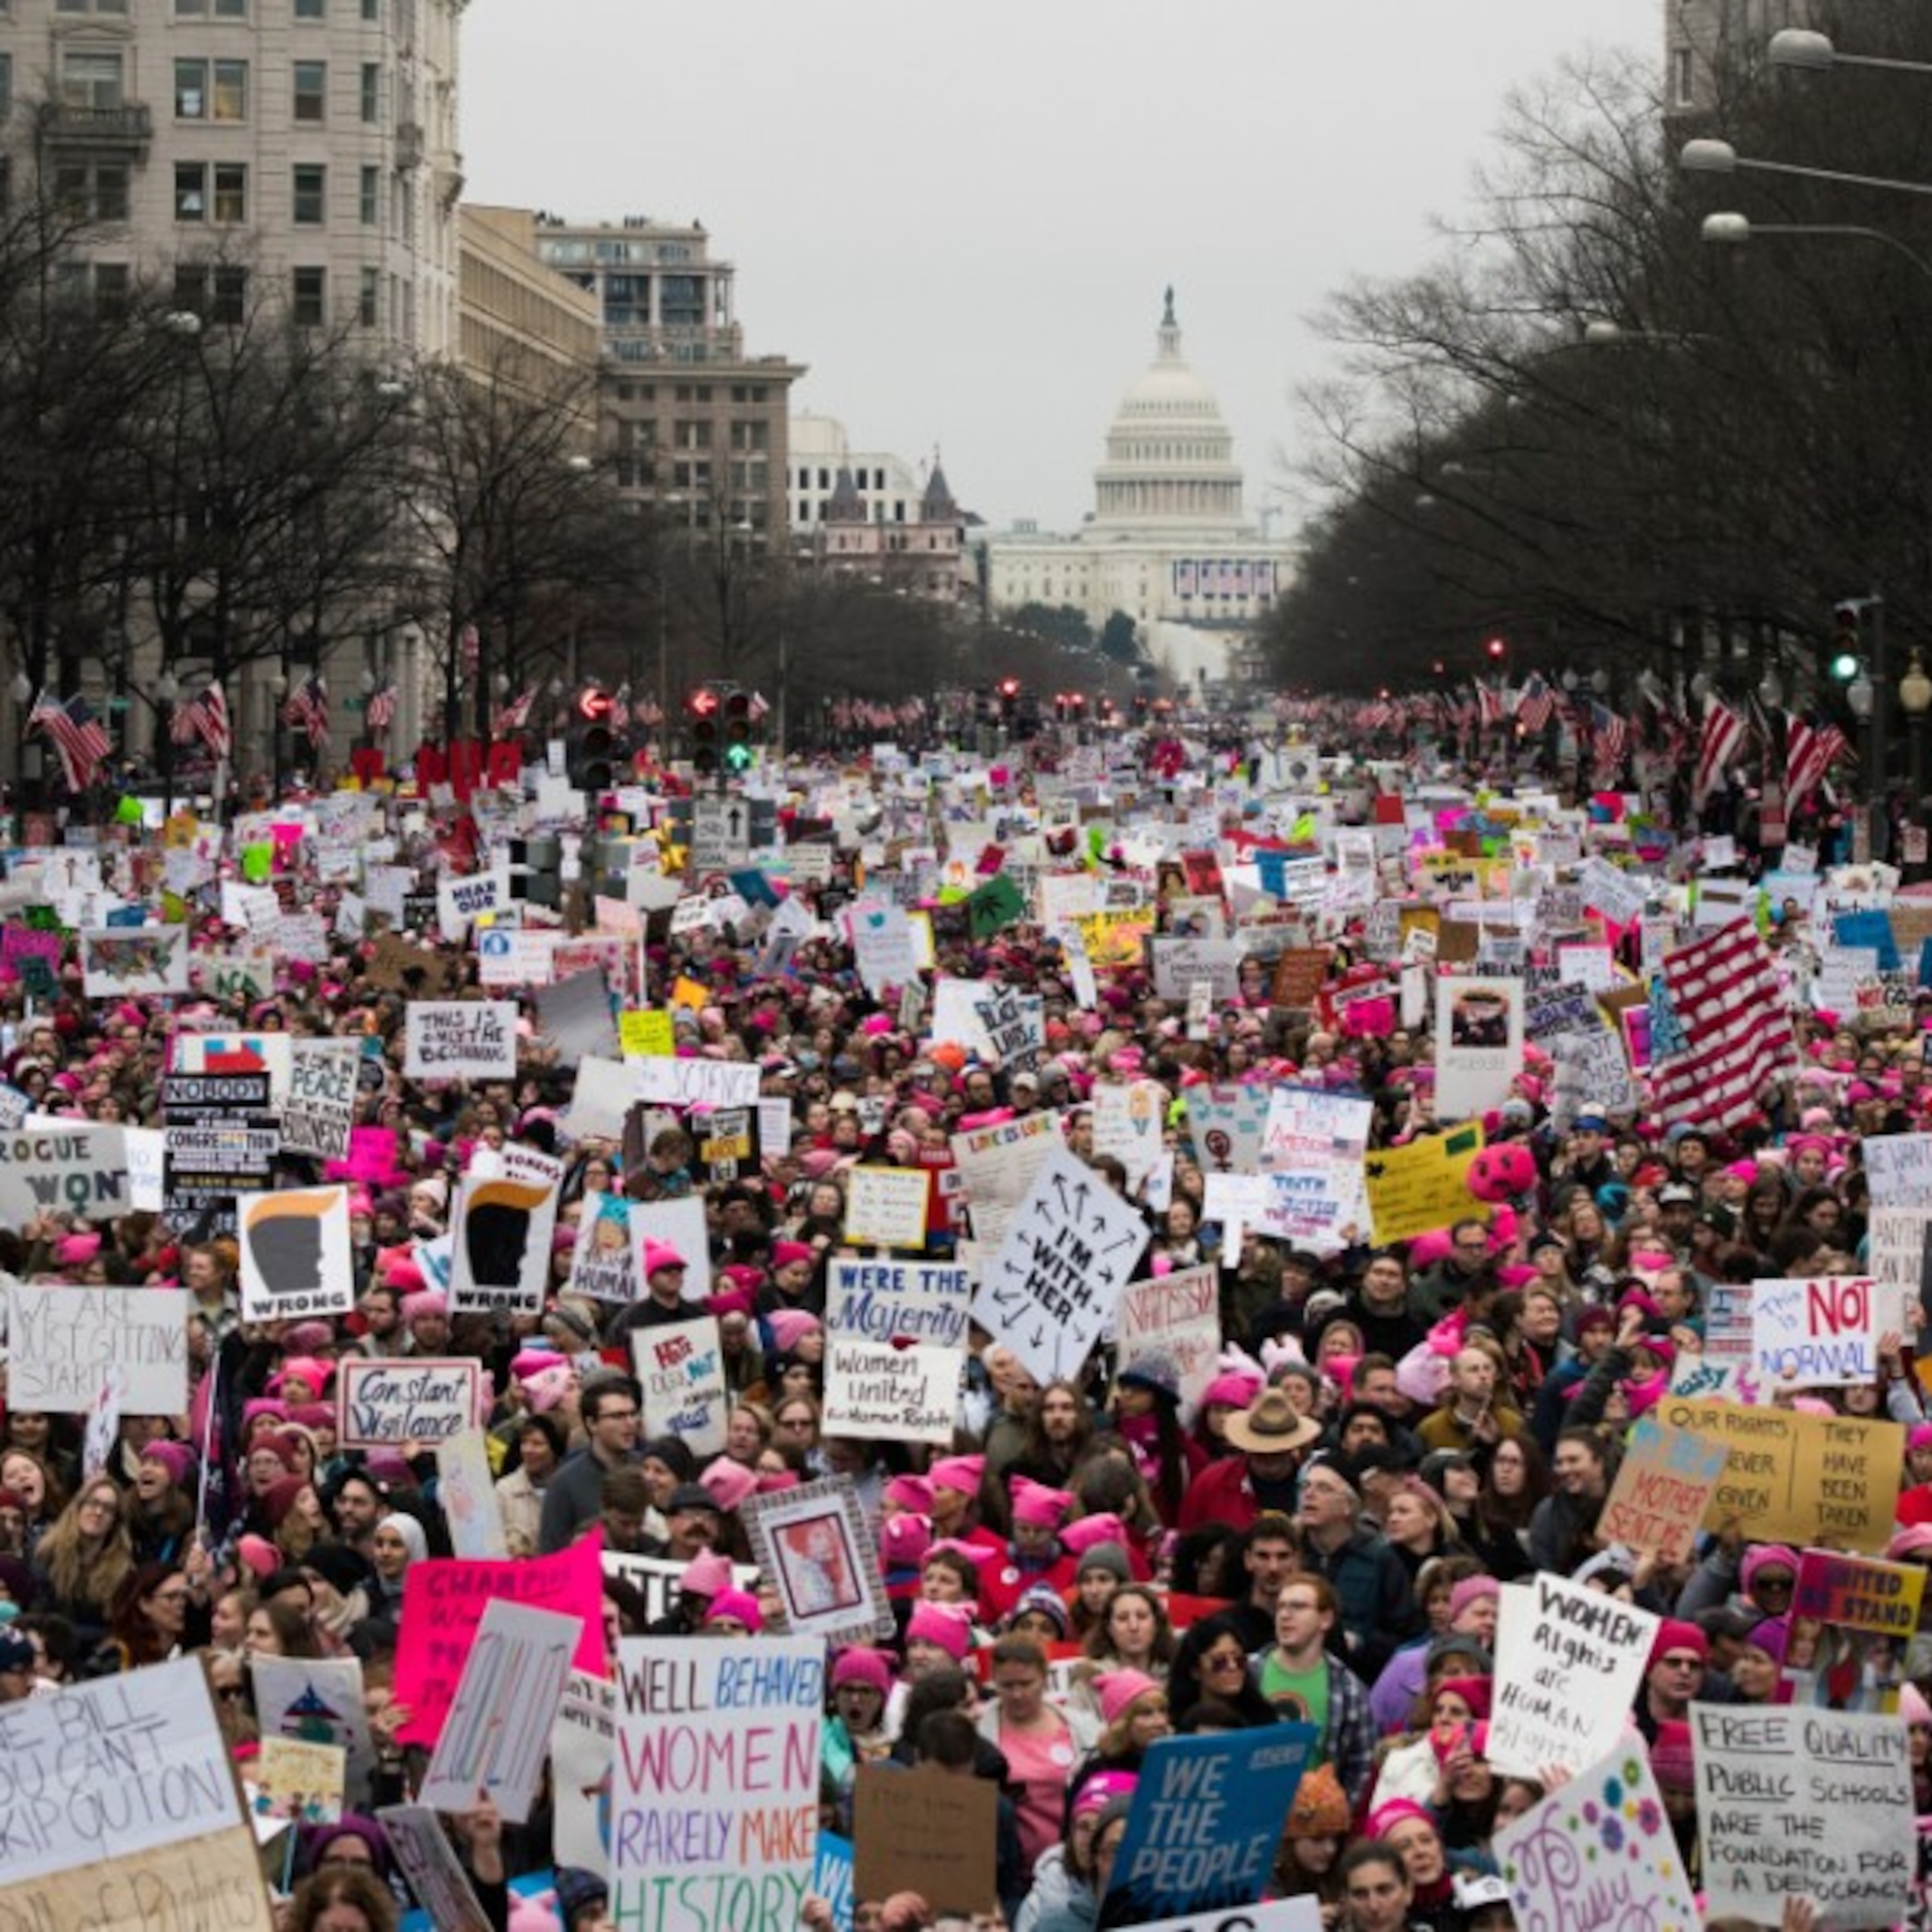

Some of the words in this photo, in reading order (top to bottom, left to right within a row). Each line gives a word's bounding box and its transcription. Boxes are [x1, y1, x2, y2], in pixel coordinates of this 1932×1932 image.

[453, 881, 497, 900] HEAR
[459, 896, 495, 914] OUR
[419, 1011, 464, 1028] THIS
[476, 1009, 497, 1027] IS
[468, 1027, 504, 1042] THE
[168, 1079, 263, 1101] NOBODY
[292, 1068, 350, 1103] PEACE
[968, 1133, 1000, 1153] LOVE
[1003, 1128, 1019, 1143] IS
[1021, 1118, 1053, 1139] LOVE
[1054, 1225, 1094, 1272] I'M
[839, 1265, 905, 1289] WERE
[920, 1269, 968, 1293] THE
[1032, 1237, 1094, 1310] WITH
[14, 1291, 53, 1323] WE
[78, 1290, 137, 1320] ARE
[252, 1293, 347, 1315] WRONG
[456, 1292, 538, 1311] WRONG
[1023, 1270, 1074, 1327] HER
[1806, 1279, 1877, 1337] NOT
[829, 1292, 967, 1342] Majority
[835, 1350, 918, 1377] Women
[1760, 1342, 1877, 1376] NORMAL
[358, 1369, 468, 1404] Constant
[848, 1377, 928, 1407] United
[1670, 1407, 1719, 1429] OUR
[1726, 1413, 1789, 1438] RIGHTS
[1822, 1424, 1870, 1443] THEY
[1728, 1451, 1776, 1476] EVER
[1823, 1454, 1868, 1475] HAVE
[1716, 1486, 1770, 1510] GIVEN
[1822, 1479, 1866, 1501] BEEN
[1815, 1503, 1869, 1528] TAKEN
[618, 1656, 708, 1715] WELL
[714, 1656, 822, 1709] BEHAVED
[51, 1684, 160, 1742] BILL
[1501, 1682, 1595, 1738] HUMAN
[1698, 1712, 1790, 1748] FREE
[1804, 1719, 1906, 1761] QUALITY
[618, 1720, 818, 1795] WOMEN
[1161, 1752, 1231, 1799] WE
[1704, 1762, 1795, 1797] PUBLIC
[1810, 1777, 1908, 1806] SCHOOLS
[0, 1795, 60, 1858] KIP
[160, 1758, 225, 1822] ON
[1146, 1802, 1227, 1846] THE
[616, 1808, 735, 1869] RARELY
[739, 1805, 817, 1868] MAKE
[1710, 1811, 1761, 1837] ARE
[1774, 1812, 1826, 1840] THE
[1130, 1833, 1271, 1893] PEOPLE
[1707, 1839, 1847, 1875] FOUNDATION
[1856, 1850, 1909, 1874] FOR
[614, 1870, 813, 1932] HISTORY
[1732, 1869, 1750, 1893] A
[1765, 1871, 1908, 1900] DEMOCRACY
